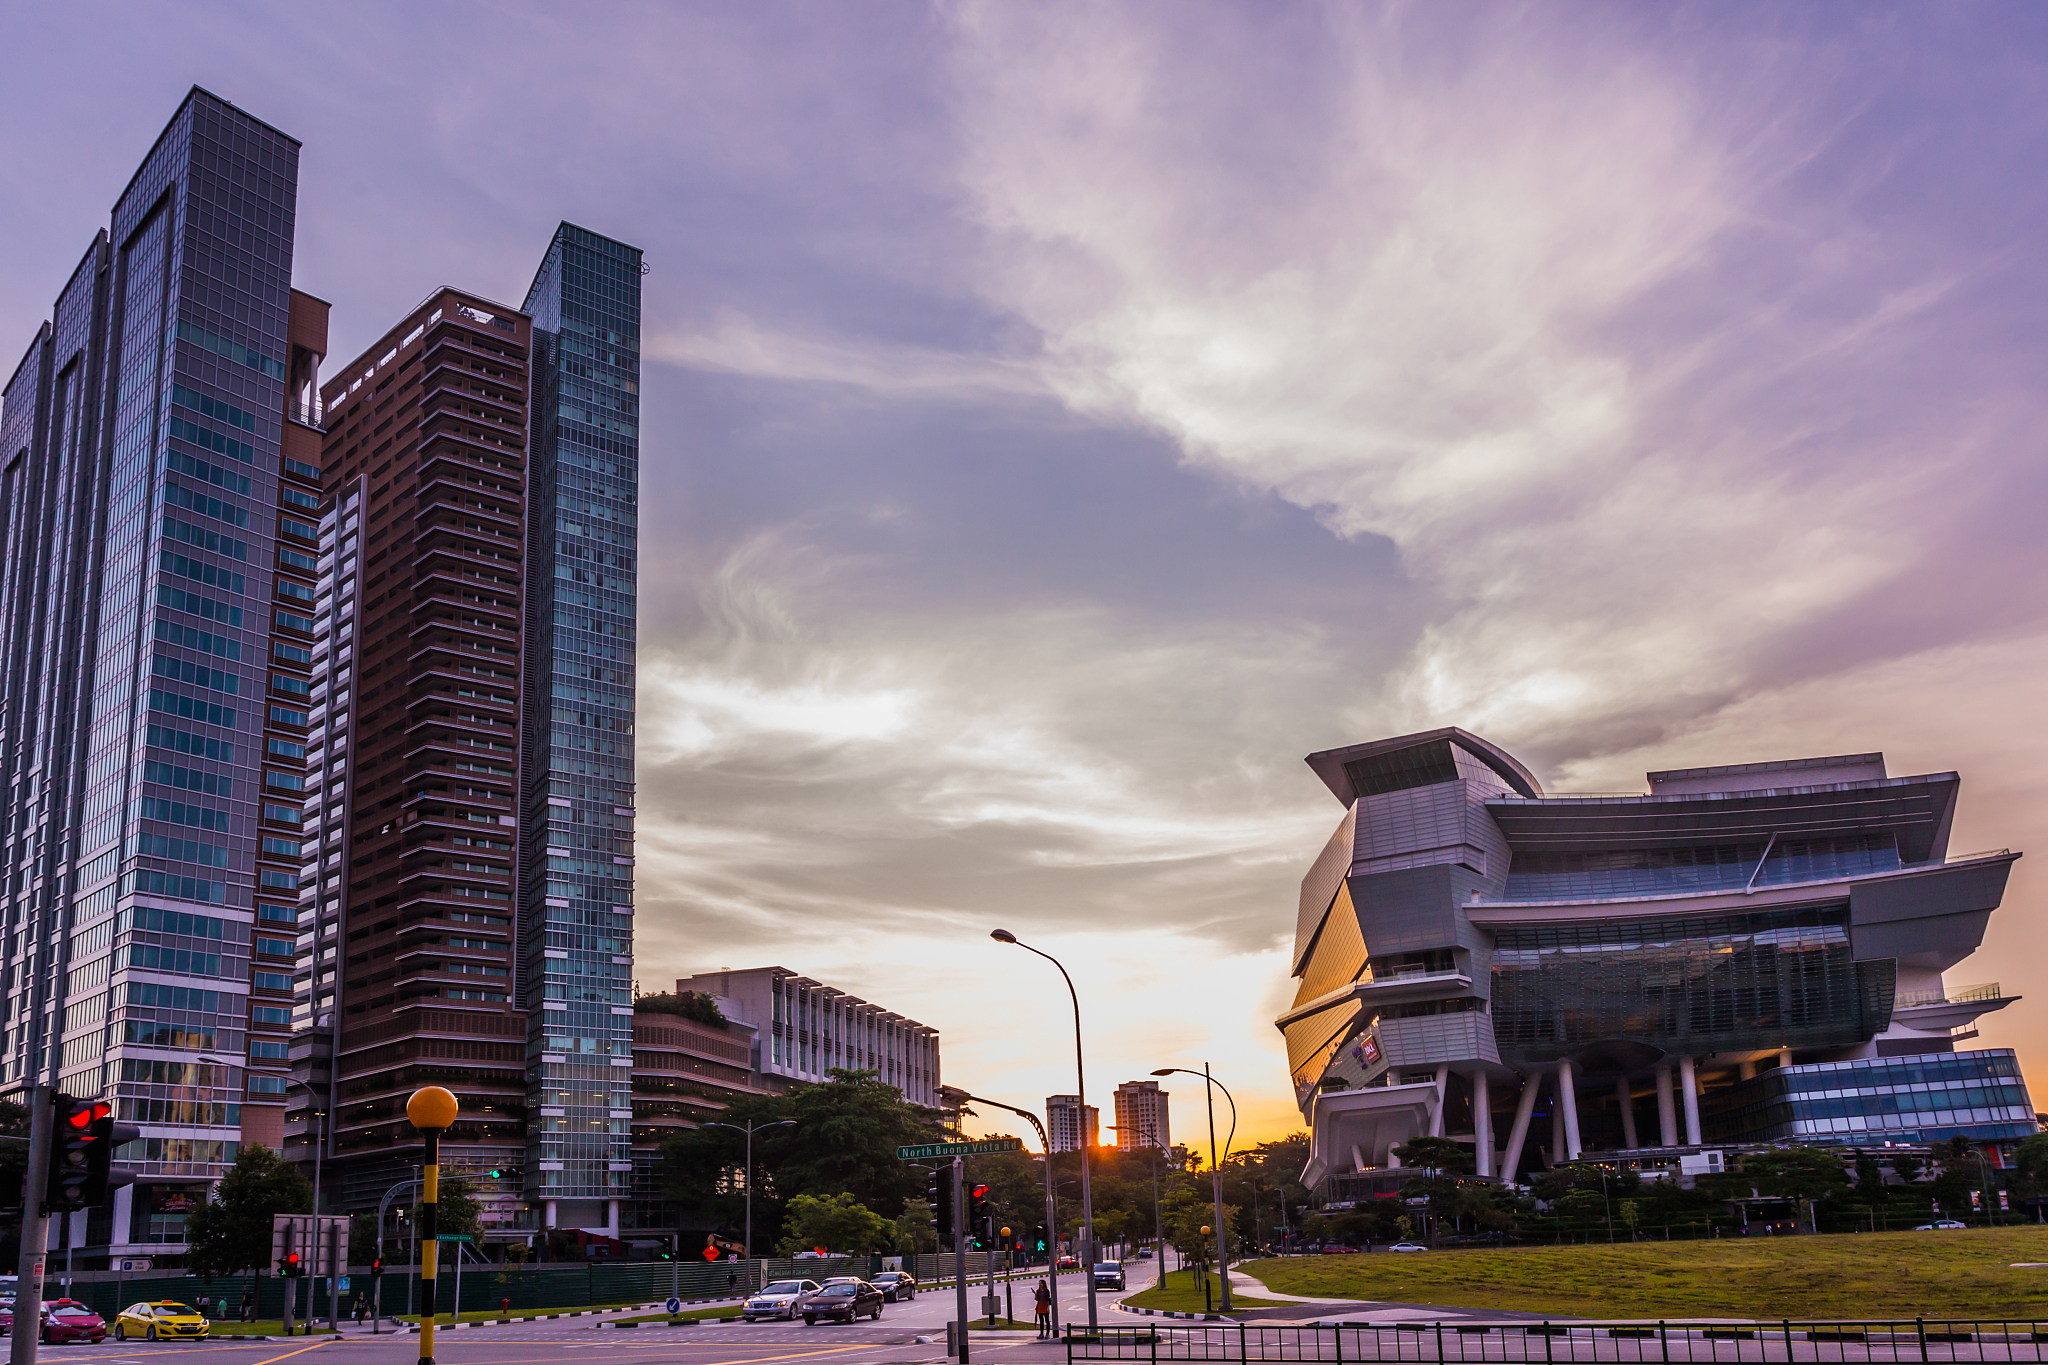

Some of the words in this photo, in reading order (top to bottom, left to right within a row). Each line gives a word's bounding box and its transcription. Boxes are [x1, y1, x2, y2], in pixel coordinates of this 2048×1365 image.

[902, 1146, 932, 1157] North
[935, 1144, 968, 1155] Buona
[971, 1142, 1000, 1152] Vista
[1003, 1139, 1017, 1150] Rd
